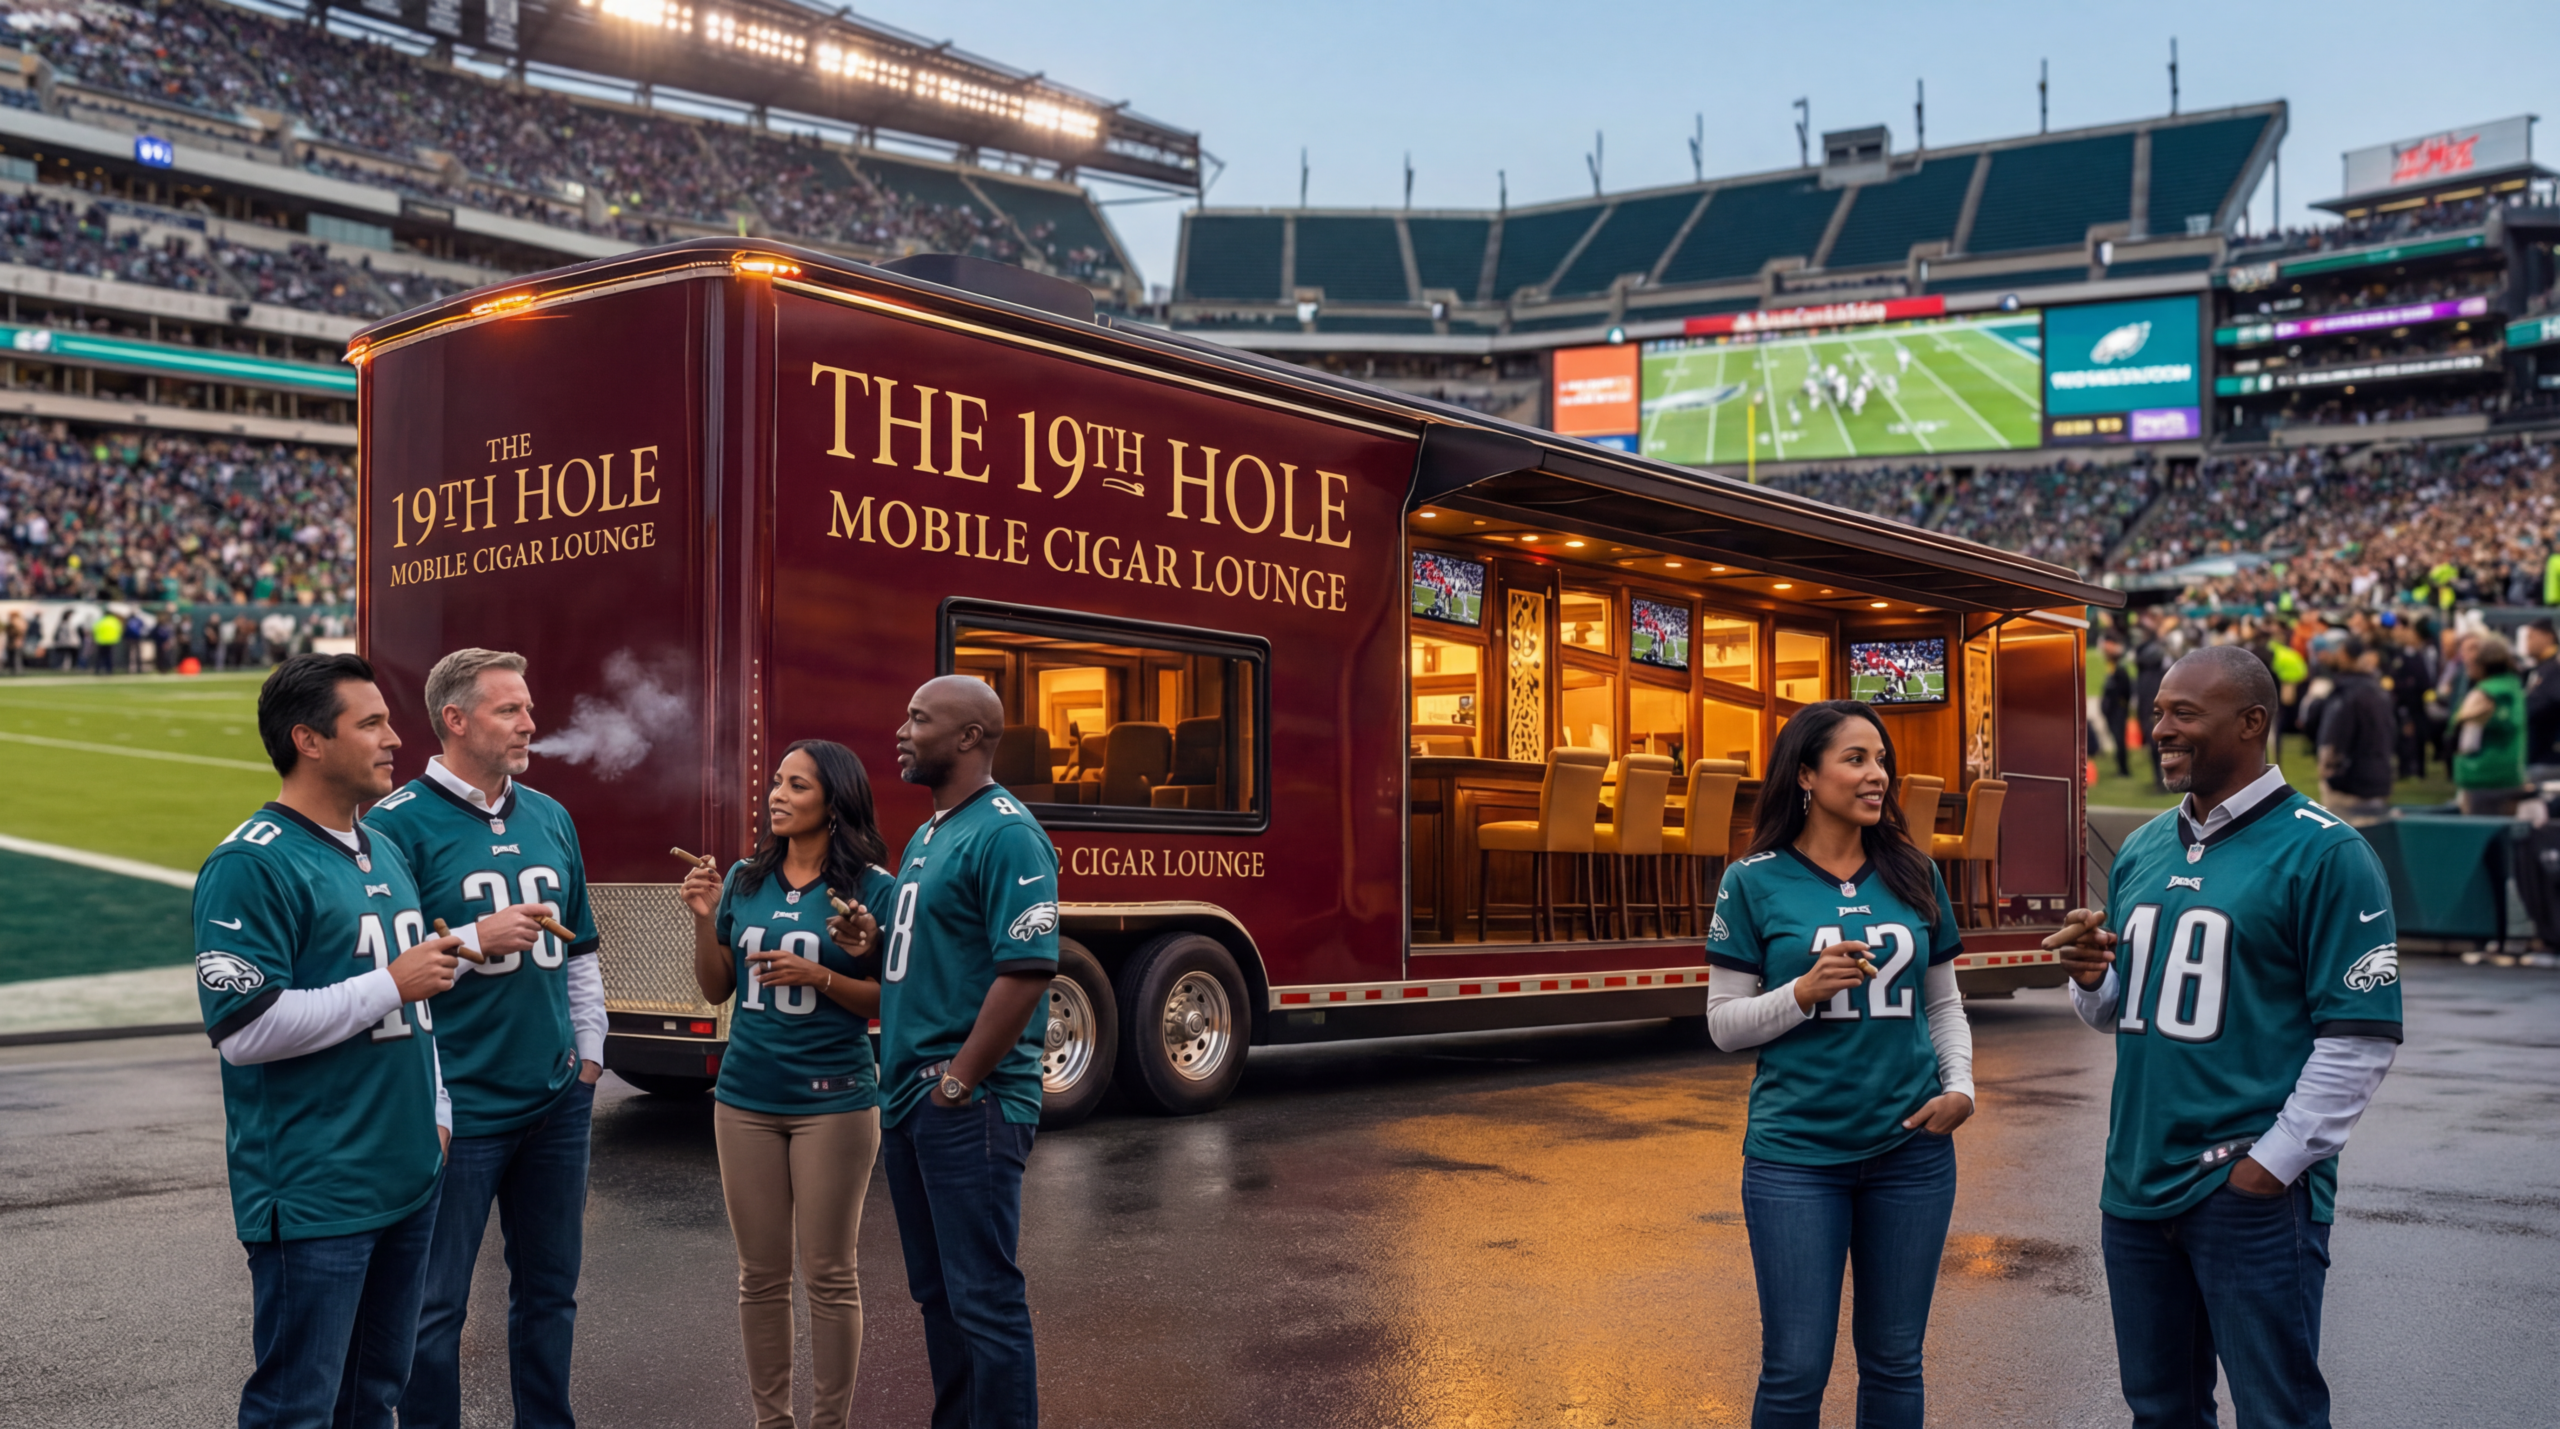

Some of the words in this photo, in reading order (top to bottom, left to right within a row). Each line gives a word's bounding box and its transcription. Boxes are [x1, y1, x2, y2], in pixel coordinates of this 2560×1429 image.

[392, 474, 497, 549] 19TH
[514, 445, 661, 524] HOLE
[486, 432, 533, 463] THE
[811, 361, 990, 484] THE
[1016, 410, 1145, 500] 19TH
[1166, 438, 1352, 549] HOLE
[390, 552, 468, 588] MOBILE
[473, 539, 545, 574] CIGAR
[550, 521, 656, 562] LOUNGE
[826, 489, 1030, 566] MOBILE
[1043, 526, 1182, 589] CIGAR
[1191, 549, 1348, 613] LOUNGE
[1071, 846, 1157, 877] CIGAR
[1163, 849, 1265, 878] LOUNGE
[885, 882, 919, 983] 8
[2118, 902, 2234, 1044] 18
